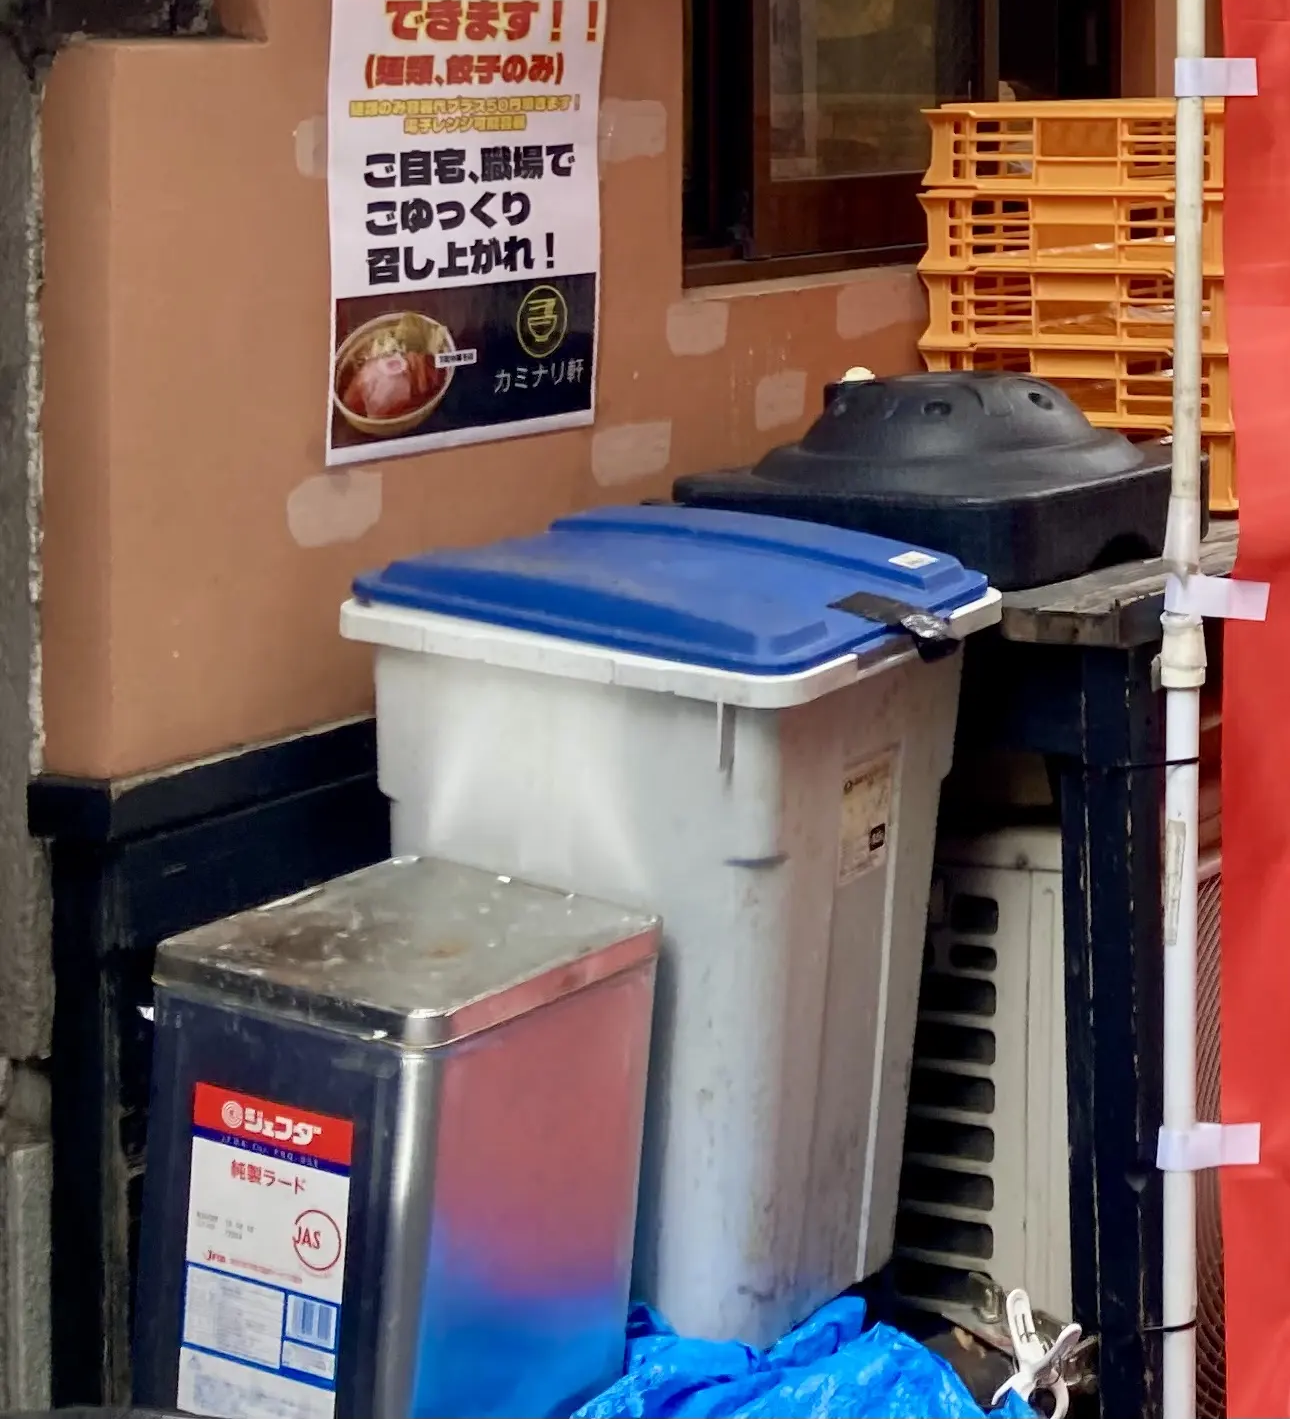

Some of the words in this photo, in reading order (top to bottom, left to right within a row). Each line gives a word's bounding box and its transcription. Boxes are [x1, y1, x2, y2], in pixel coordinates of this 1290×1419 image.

[363, 143, 576, 189] ご自宅、職場で
[365, 191, 532, 236] ごゆっくり
[494, 357, 585, 394] カミナリ軒
[244, 1107, 322, 1146] ジェフダ
[292, 1226, 321, 1250] JAS
